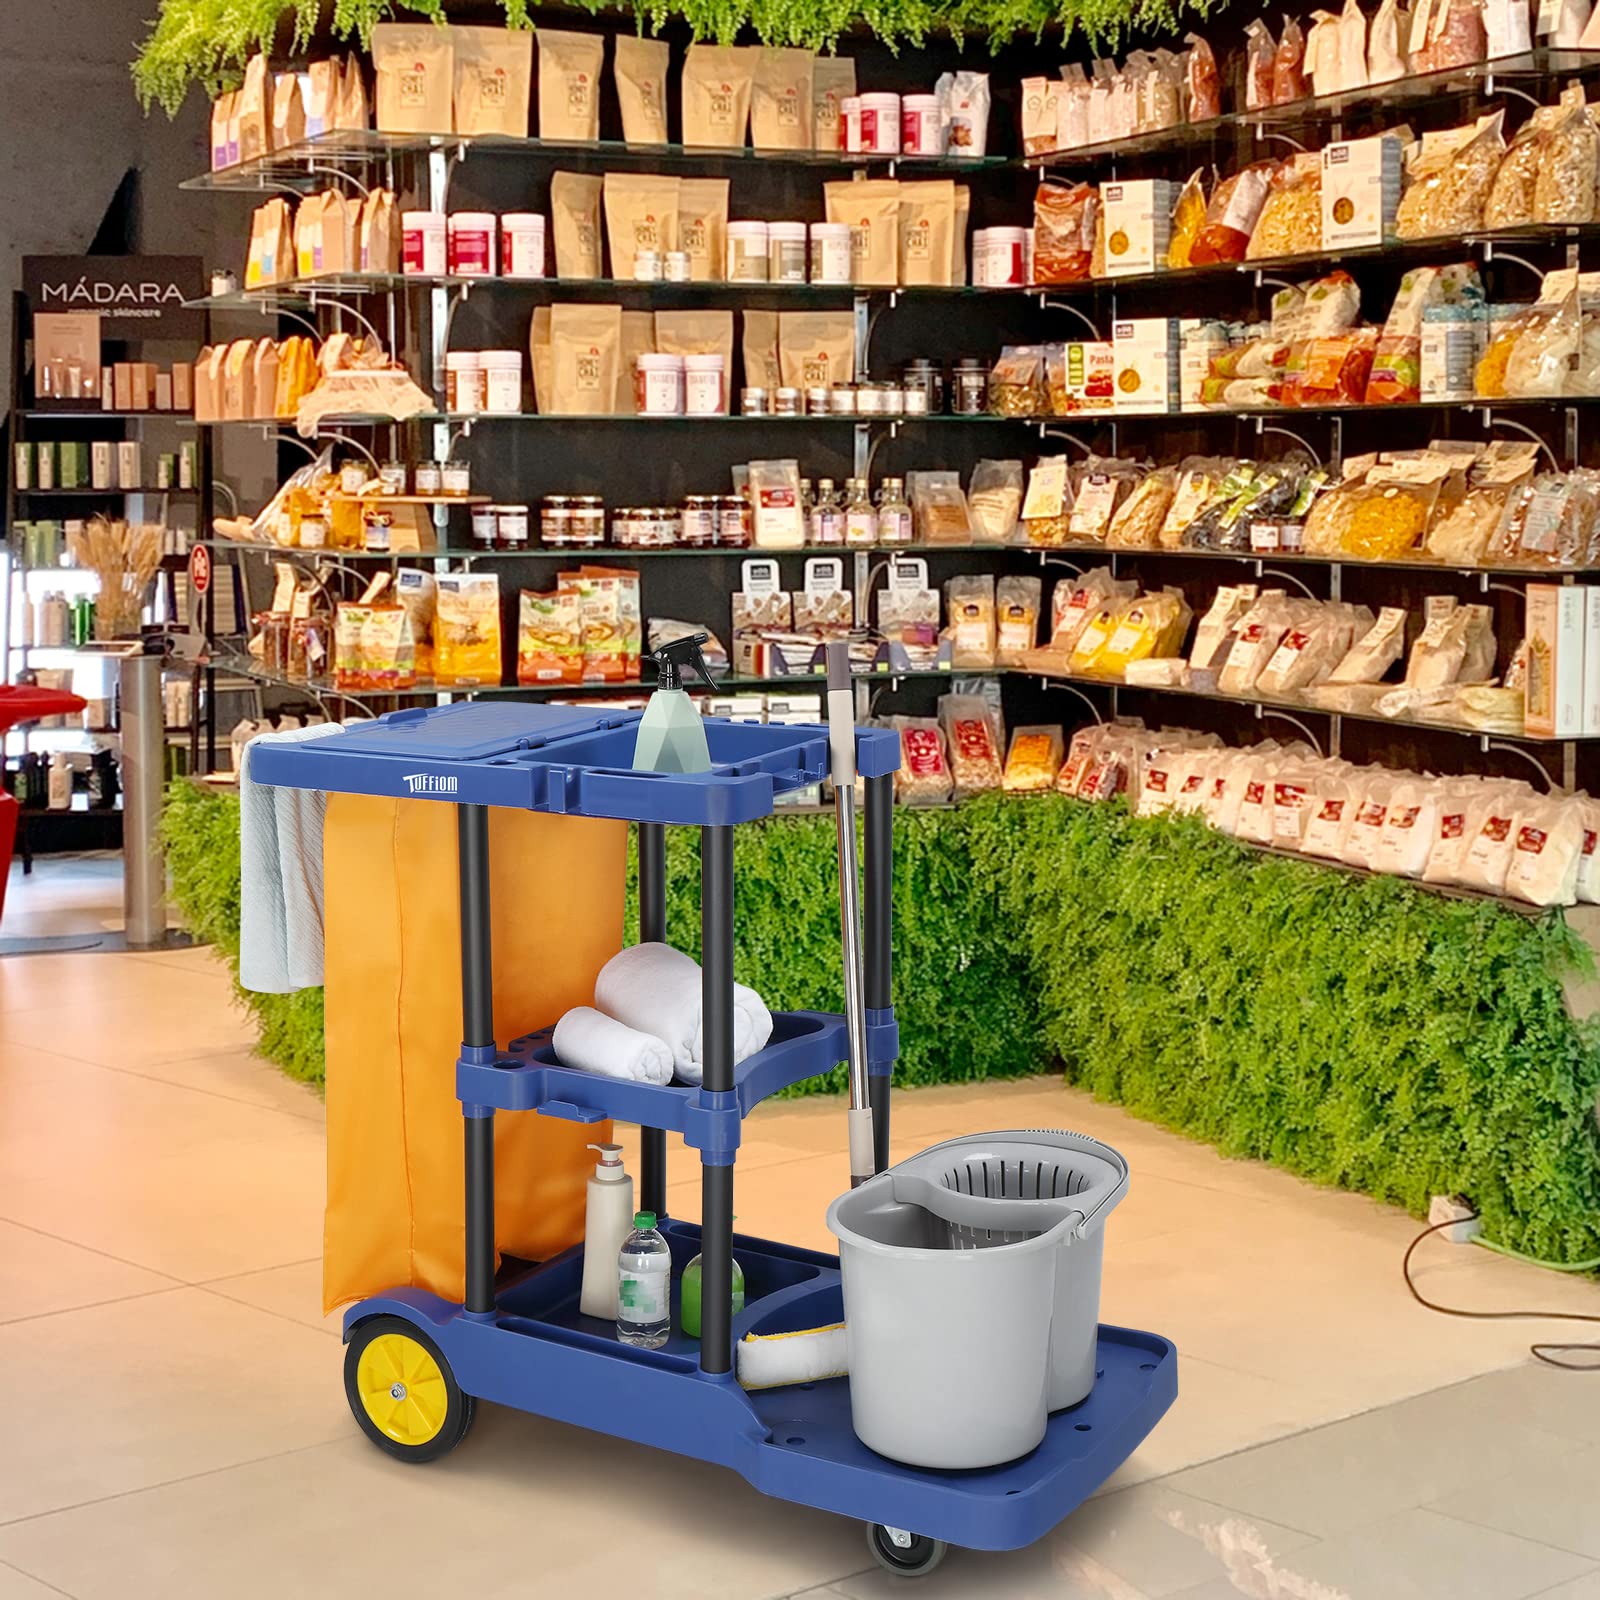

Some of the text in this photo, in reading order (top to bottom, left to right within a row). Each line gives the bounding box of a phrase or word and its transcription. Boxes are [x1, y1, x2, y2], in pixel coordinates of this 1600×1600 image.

[42, 276, 185, 303] MÁDARA
[113, 307, 162, 317] skincare
[1089, 355, 1115, 365] Pasta
